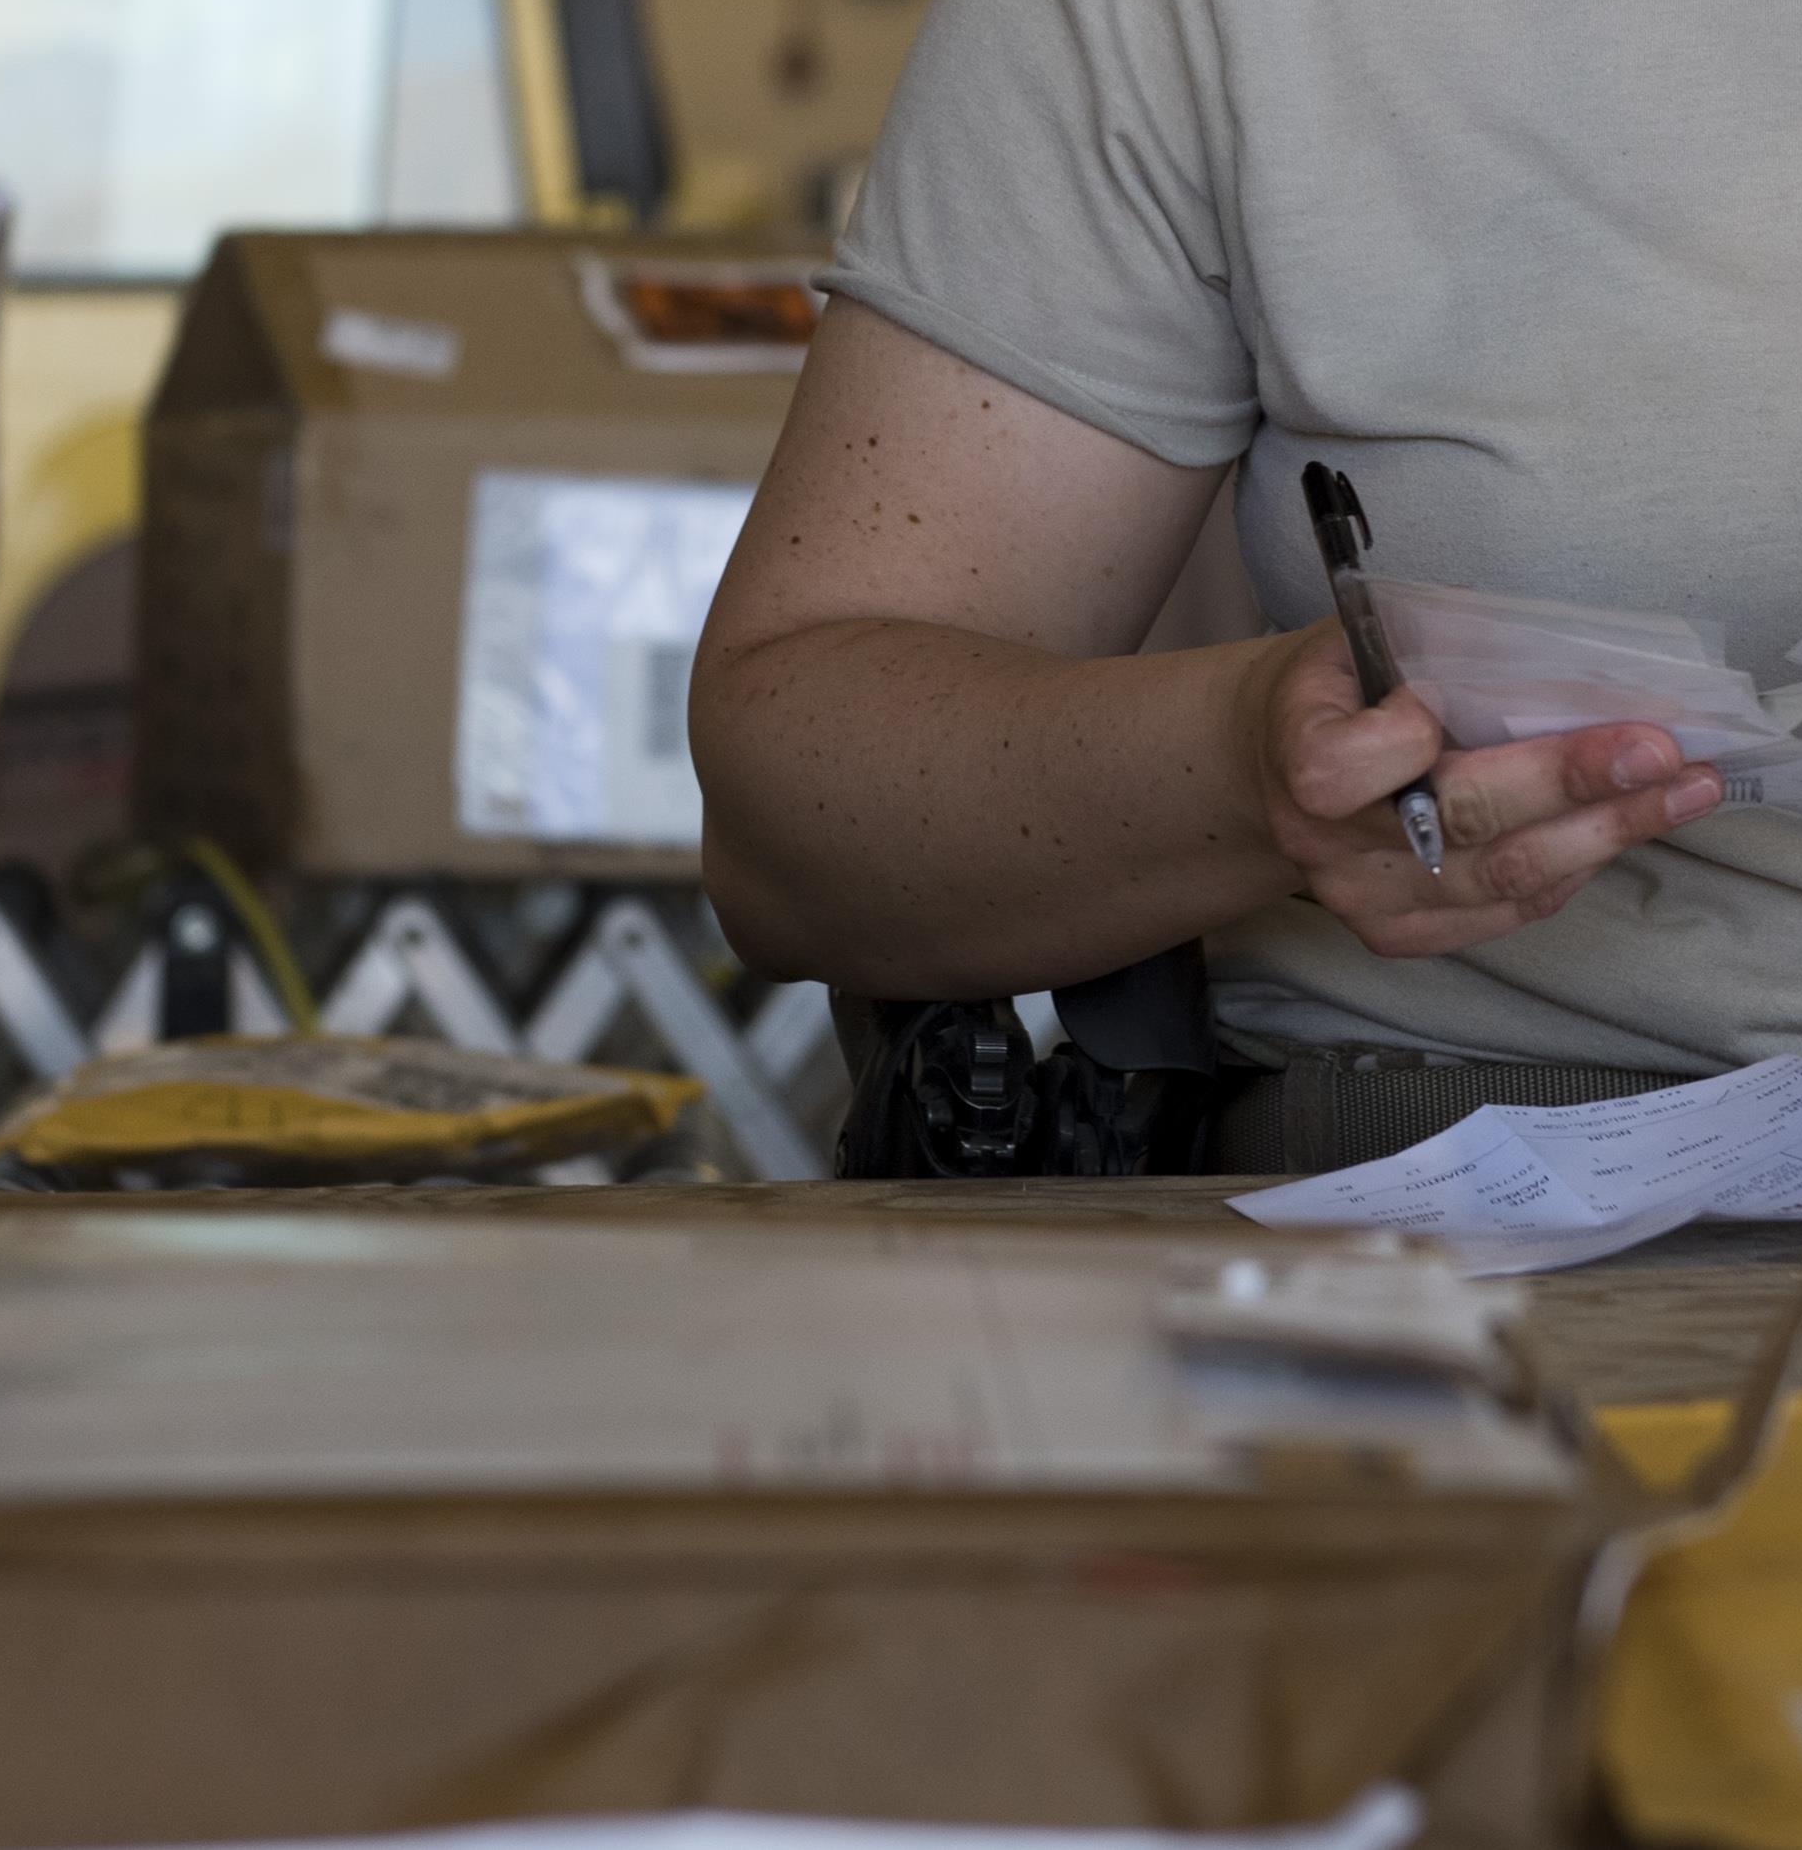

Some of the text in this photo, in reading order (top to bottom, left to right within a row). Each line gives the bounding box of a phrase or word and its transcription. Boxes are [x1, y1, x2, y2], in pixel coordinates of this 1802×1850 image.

[1586, 1128, 1634, 1143] NOUN
[1666, 1134, 1724, 1159] WEIGHT
[1404, 1162, 1478, 1193] QUANTITY
[1489, 1174, 1551, 1206] PACKED
[1507, 1186, 1548, 1208] DATE
